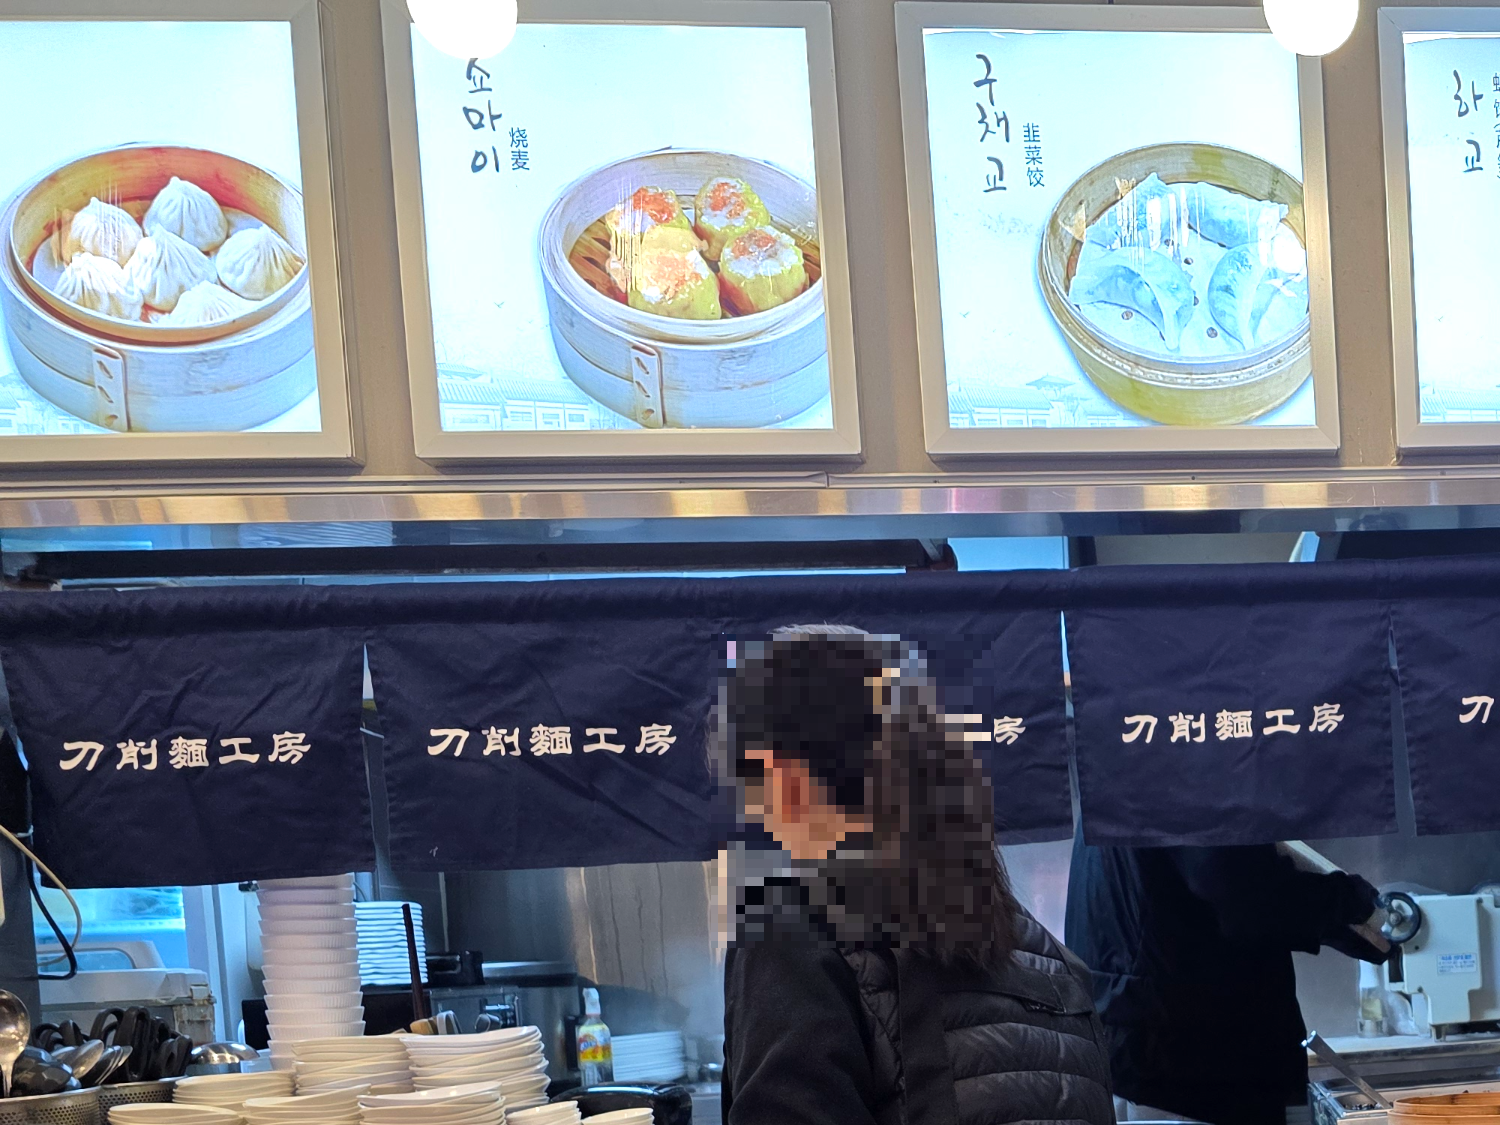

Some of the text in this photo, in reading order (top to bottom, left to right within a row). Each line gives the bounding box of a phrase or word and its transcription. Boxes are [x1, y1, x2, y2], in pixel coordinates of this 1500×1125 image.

[973, 53, 1010, 193] 구채교
[1452, 69, 1484, 173] 하교
[508, 126, 530, 171] 烧麦
[1022, 122, 1045, 188] 韭菜饺
[427, 723, 677, 757] 刀削麵工房
[1121, 702, 1345, 744] 刀削麵工房
[60, 730, 312, 771] 刀削麵工房
